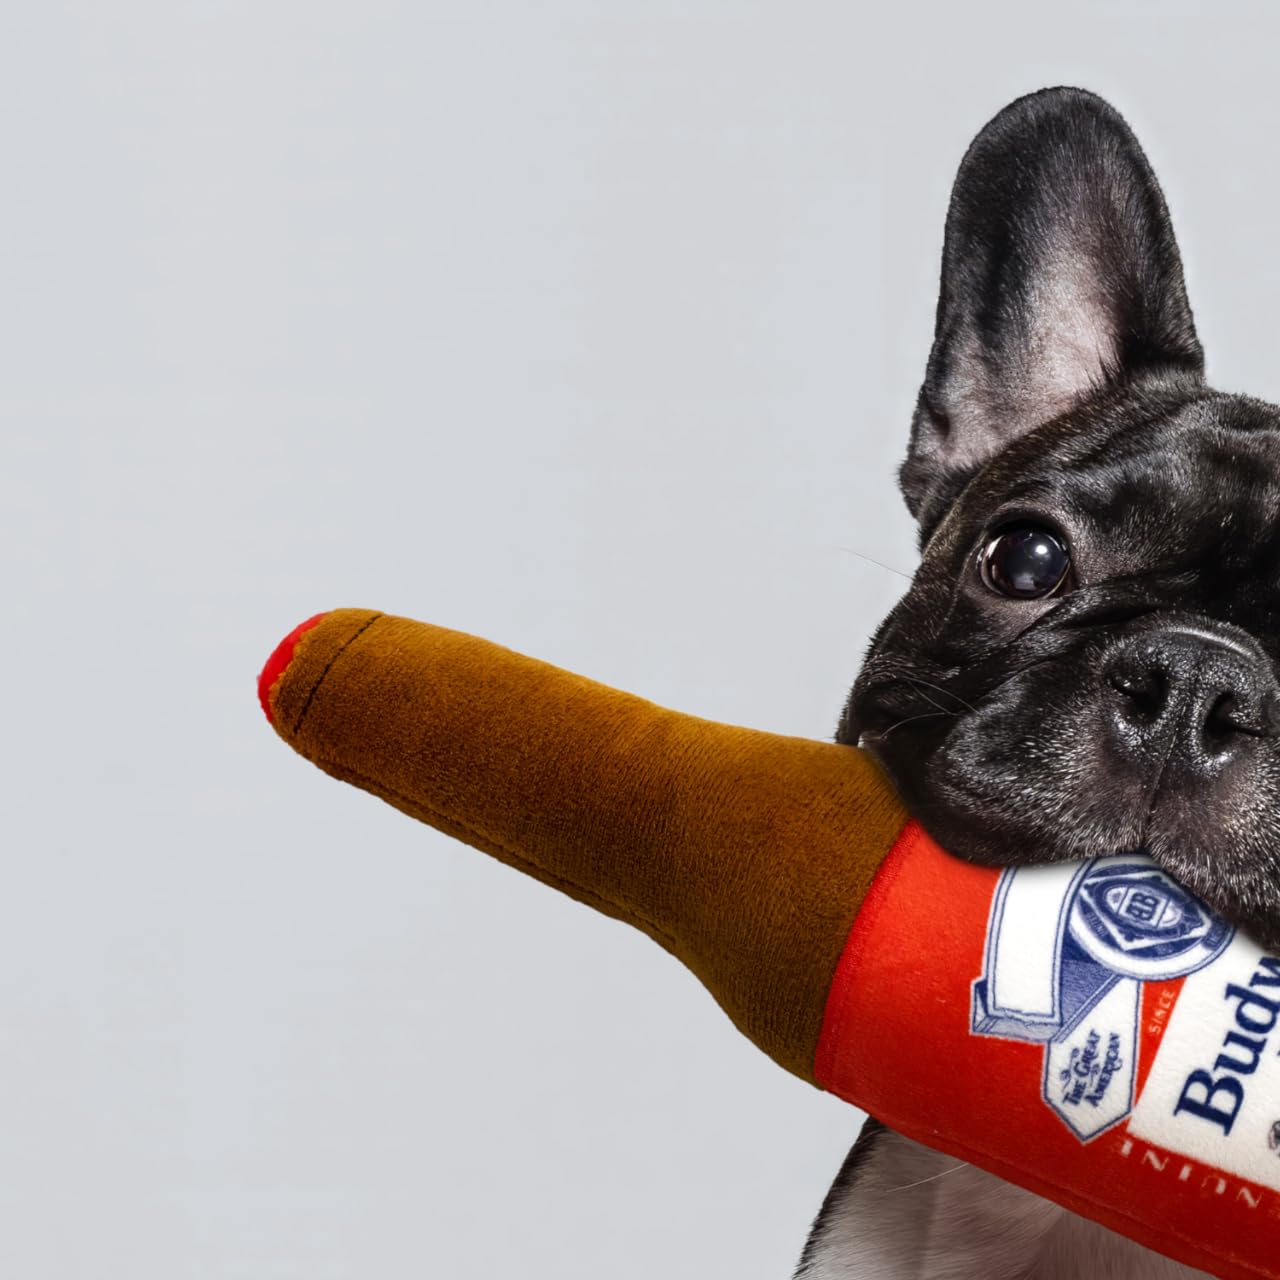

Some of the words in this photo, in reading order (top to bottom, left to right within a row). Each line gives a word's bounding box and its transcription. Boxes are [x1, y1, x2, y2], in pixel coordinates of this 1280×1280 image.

[1148, 989, 1175, 1035] SINCE
[1074, 1028, 1101, 1077] GREAT
[1084, 1032, 1122, 1107] AMERICAN
[1062, 1079, 1087, 1105] THE
